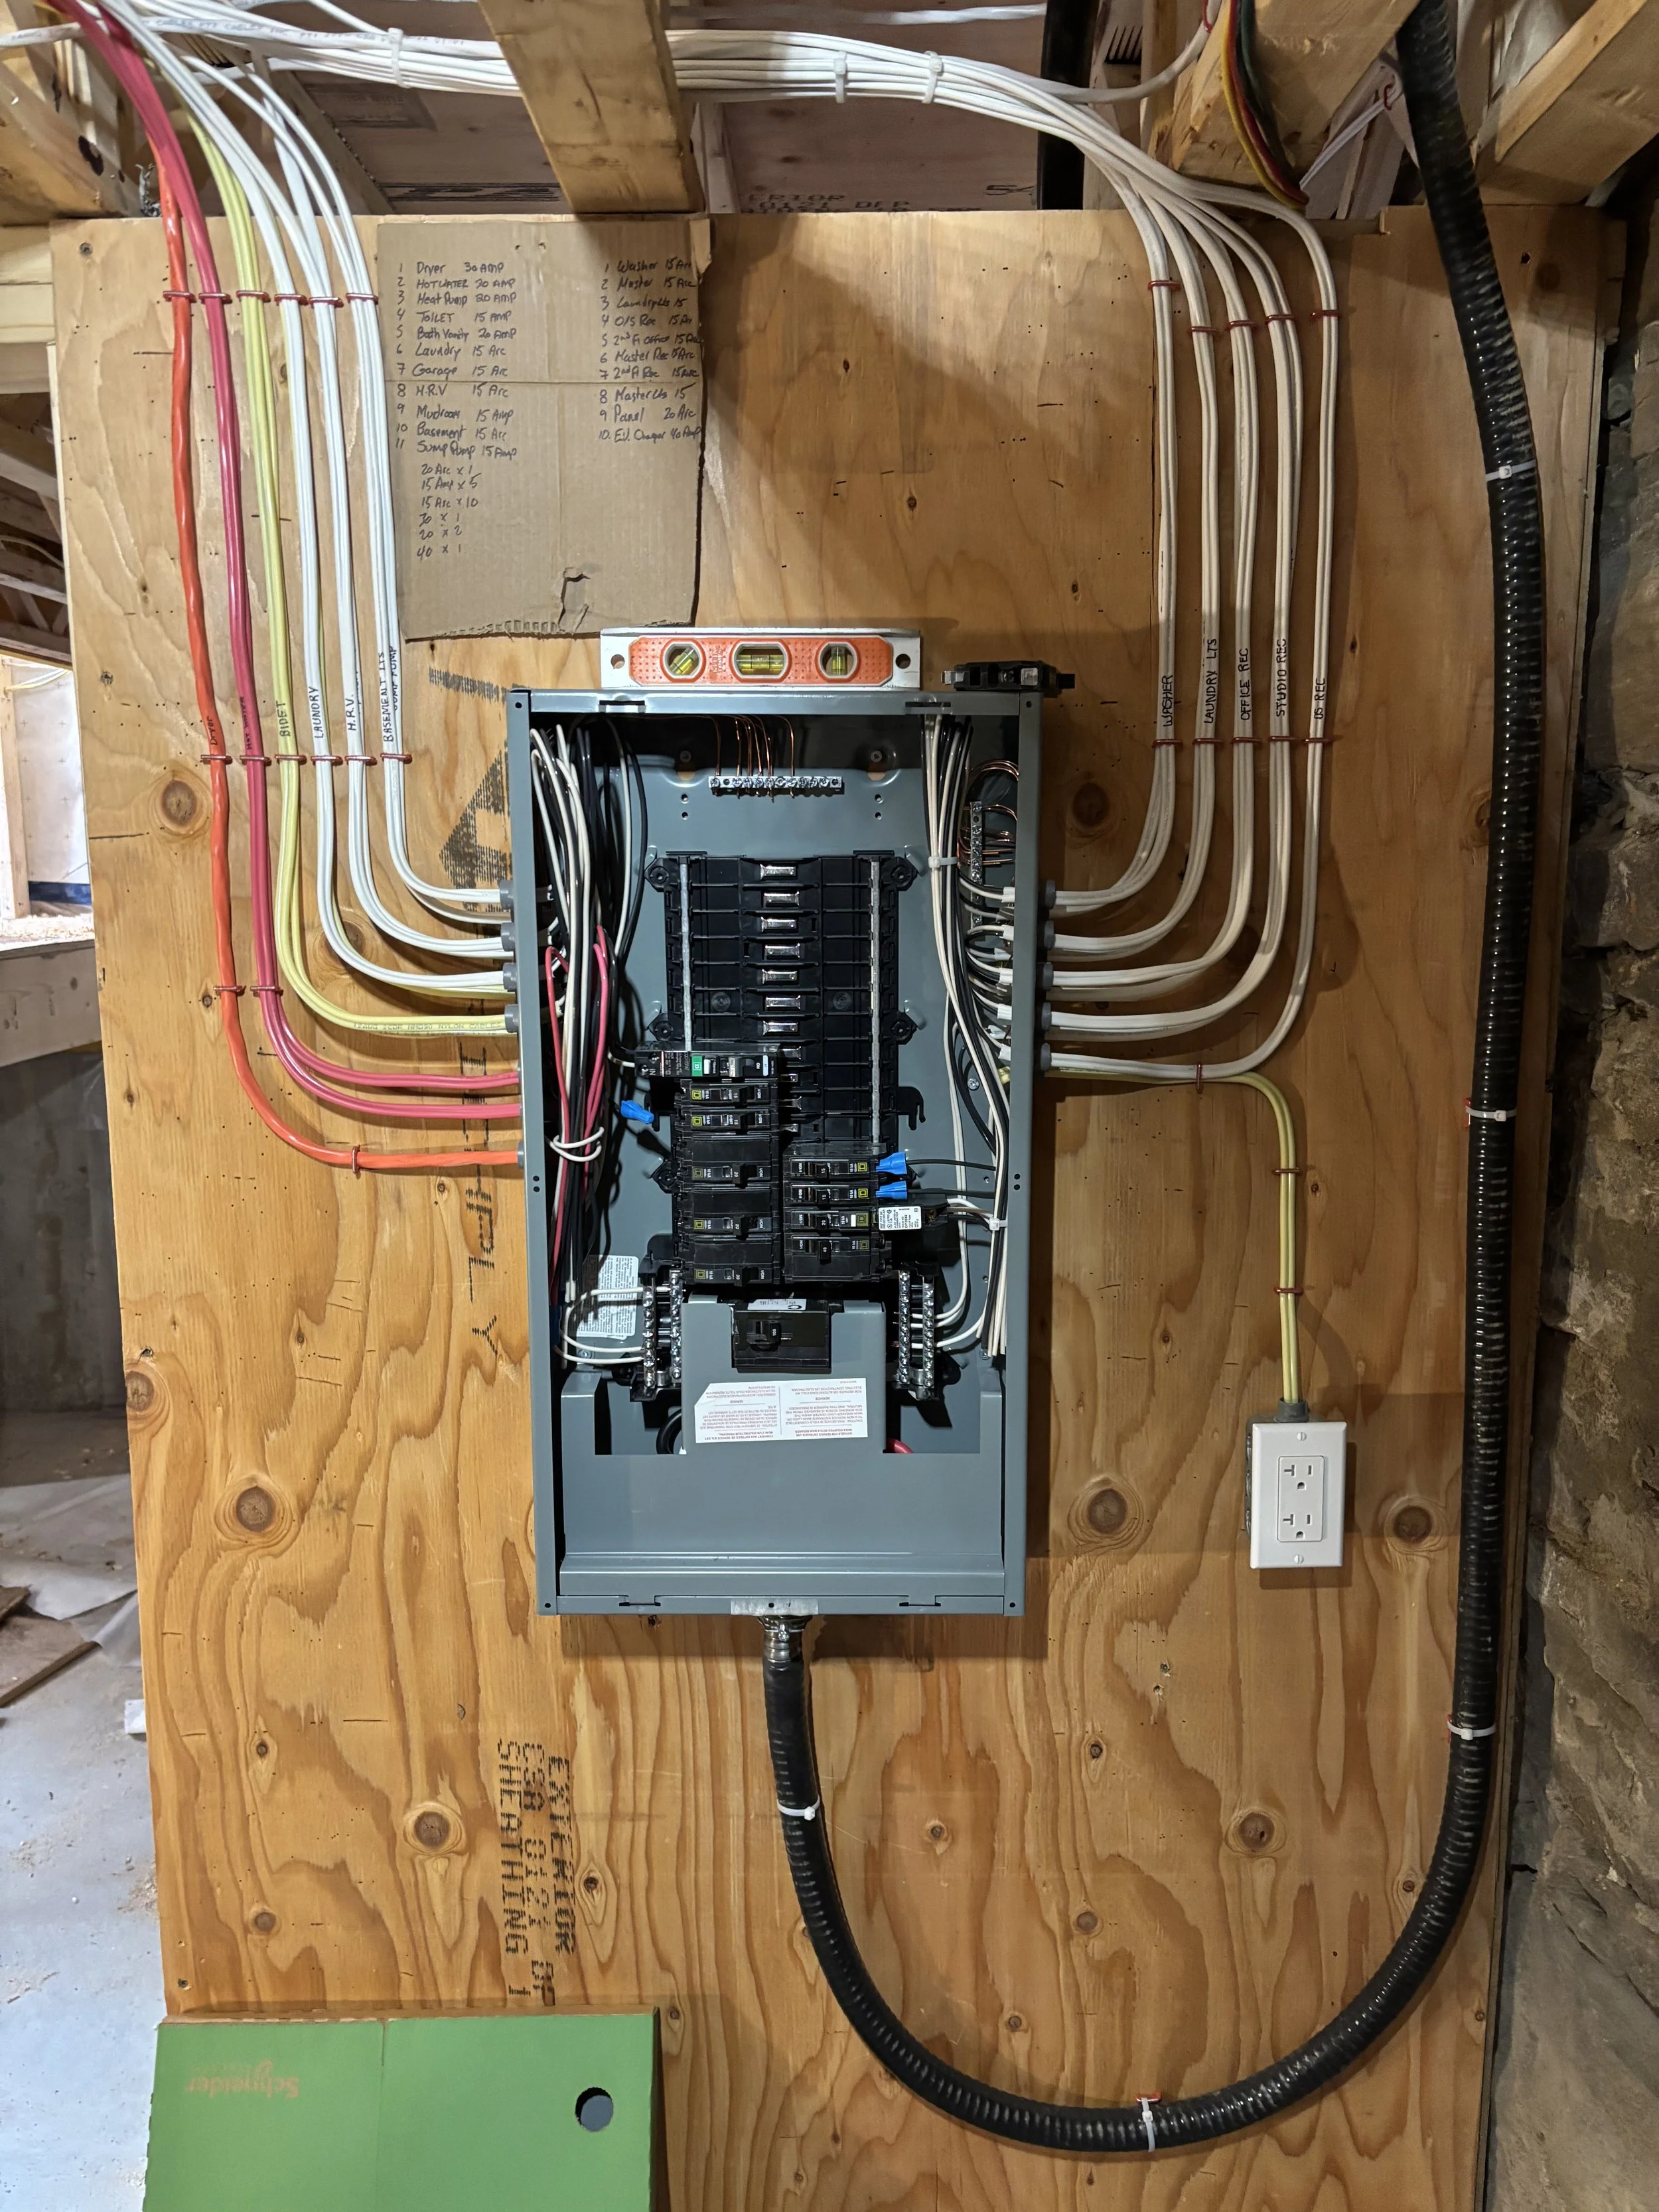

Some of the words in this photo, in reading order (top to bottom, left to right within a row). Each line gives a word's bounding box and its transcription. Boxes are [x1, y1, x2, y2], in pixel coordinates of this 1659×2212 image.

[399, 263, 402, 272] 1
[417, 261, 446, 275] Dryer
[465, 263, 477, 272] 30
[618, 260, 658, 273] Washer
[666, 258, 678, 269] 15
[398, 277, 405, 287] 2
[476, 279, 488, 288] 20
[601, 279, 608, 290] 2
[617, 277, 653, 291] Master
[665, 277, 676, 287] 15
[678, 279, 696, 287] Arc
[398, 291, 405, 304] 3
[417, 292, 442, 304] Heat
[444, 291, 467, 307] Pump
[476, 293, 490, 302] 20
[601, 297, 609, 310] 3
[397, 308, 405, 321] 4
[474, 311, 487, 322] 15
[602, 315, 609, 327] 4
[640, 314, 655, 326] Rec
[669, 315, 680, 325] 15
[397, 325, 402, 338] 5
[417, 327, 440, 340] Bath
[443, 328, 469, 342] Vanity
[478, 328, 490, 338] 20
[602, 334, 607, 346] 5
[675, 334, 685, 344] 15
[397, 344, 402, 354] 6
[415, 342, 461, 361] Laundry
[473, 346, 484, 356] 15
[489, 345, 506, 356] Arc
[600, 353, 607, 363] 6
[615, 349, 649, 362] Master
[654, 347, 668, 362] Rec
[672, 347, 681, 358] 15
[678, 348, 695, 360] Arc
[397, 363, 405, 375] 7
[412, 364, 457, 380] Garage
[472, 366, 486, 376] 15
[491, 366, 508, 376] Arc
[600, 369, 608, 380] 7
[643, 366, 659, 379] Rec
[672, 366, 685, 377] 15
[398, 384, 405, 397] 8
[473, 382, 488, 396] 15
[489, 385, 508, 397] Arc
[600, 390, 607, 404] 8
[615, 387, 652, 402] Master
[675, 383, 695, 399] 15
[397, 404, 405, 414] 9
[417, 404, 461, 419] Mudroom
[476, 409, 490, 422] 15
[492, 409, 513, 425] Amp
[600, 410, 607, 421] 9
[614, 404, 644, 423] Panel
[664, 407, 675, 419] 20
[678, 404, 695, 420] Arc
[397, 423, 408, 432] 10
[417, 421, 467, 441] Basement
[476, 427, 487, 440] 15
[492, 428, 506, 440] Arc
[671, 428, 680, 439] 40
[396, 438, 405, 449] 11
[417, 440, 448, 457] Sump
[450, 440, 475, 459] Pump
[482, 445, 494, 455] 15
[421, 463, 433, 475] 20
[435, 463, 451, 475] Arc
[469, 465, 472, 475] 1
[421, 477, 435, 491] 15
[435, 477, 453, 490] Amp
[470, 473, 481, 488] 5
[421, 496, 433, 508] 15
[435, 497, 451, 508] Arc
[467, 496, 478, 508] 10
[419, 512, 432, 527] 30
[457, 513, 459, 522] 1
[419, 530, 433, 540] 20
[455, 525, 462, 536] 2
[417, 546, 432, 560] 40
[1206, 638, 1218, 659] LTS
[1276, 638, 1287, 663] REC
[1238, 648, 1250, 672] REC
[1204, 670, 1218, 723] LAUNDRY
[1276, 669, 1287, 717] STUDIO
[1315, 678, 1325, 701] REC
[380, 677, 394, 742] BASEMENT
[1161, 675, 1173, 727] WASHER
[1240, 680, 1252, 720] OFFICE
[276, 700, 291, 737] BIDET
[309, 686, 324, 739] LAUNDRY
[345, 694, 356, 731] H.R.V.
[207, 716, 218, 745] Dryer
[523, 1743, 545, 1811] CSA
[498, 1738, 529, 1954] SHEATHING
[548, 1756, 575, 1954] EXTERIOR
